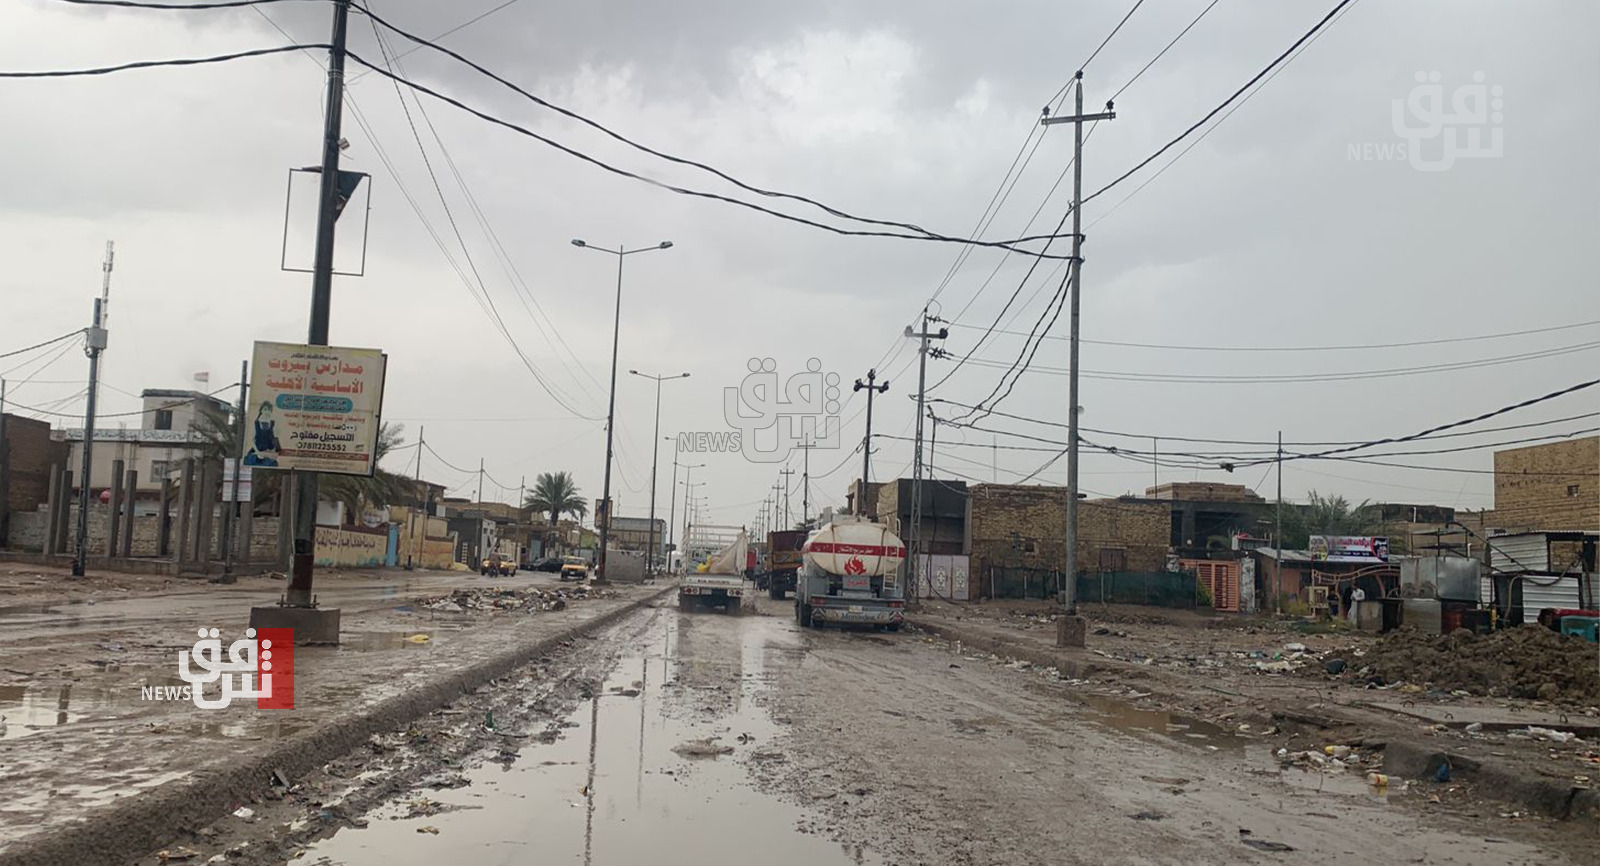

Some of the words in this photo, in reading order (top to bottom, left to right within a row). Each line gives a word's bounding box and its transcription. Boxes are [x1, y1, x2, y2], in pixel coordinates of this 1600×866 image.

[268, 358, 311, 374] بيروت
[316, 360, 364, 375] مدارس
[289, 431, 319, 441] مفتوح
[319, 432, 355, 443] التسجيل
